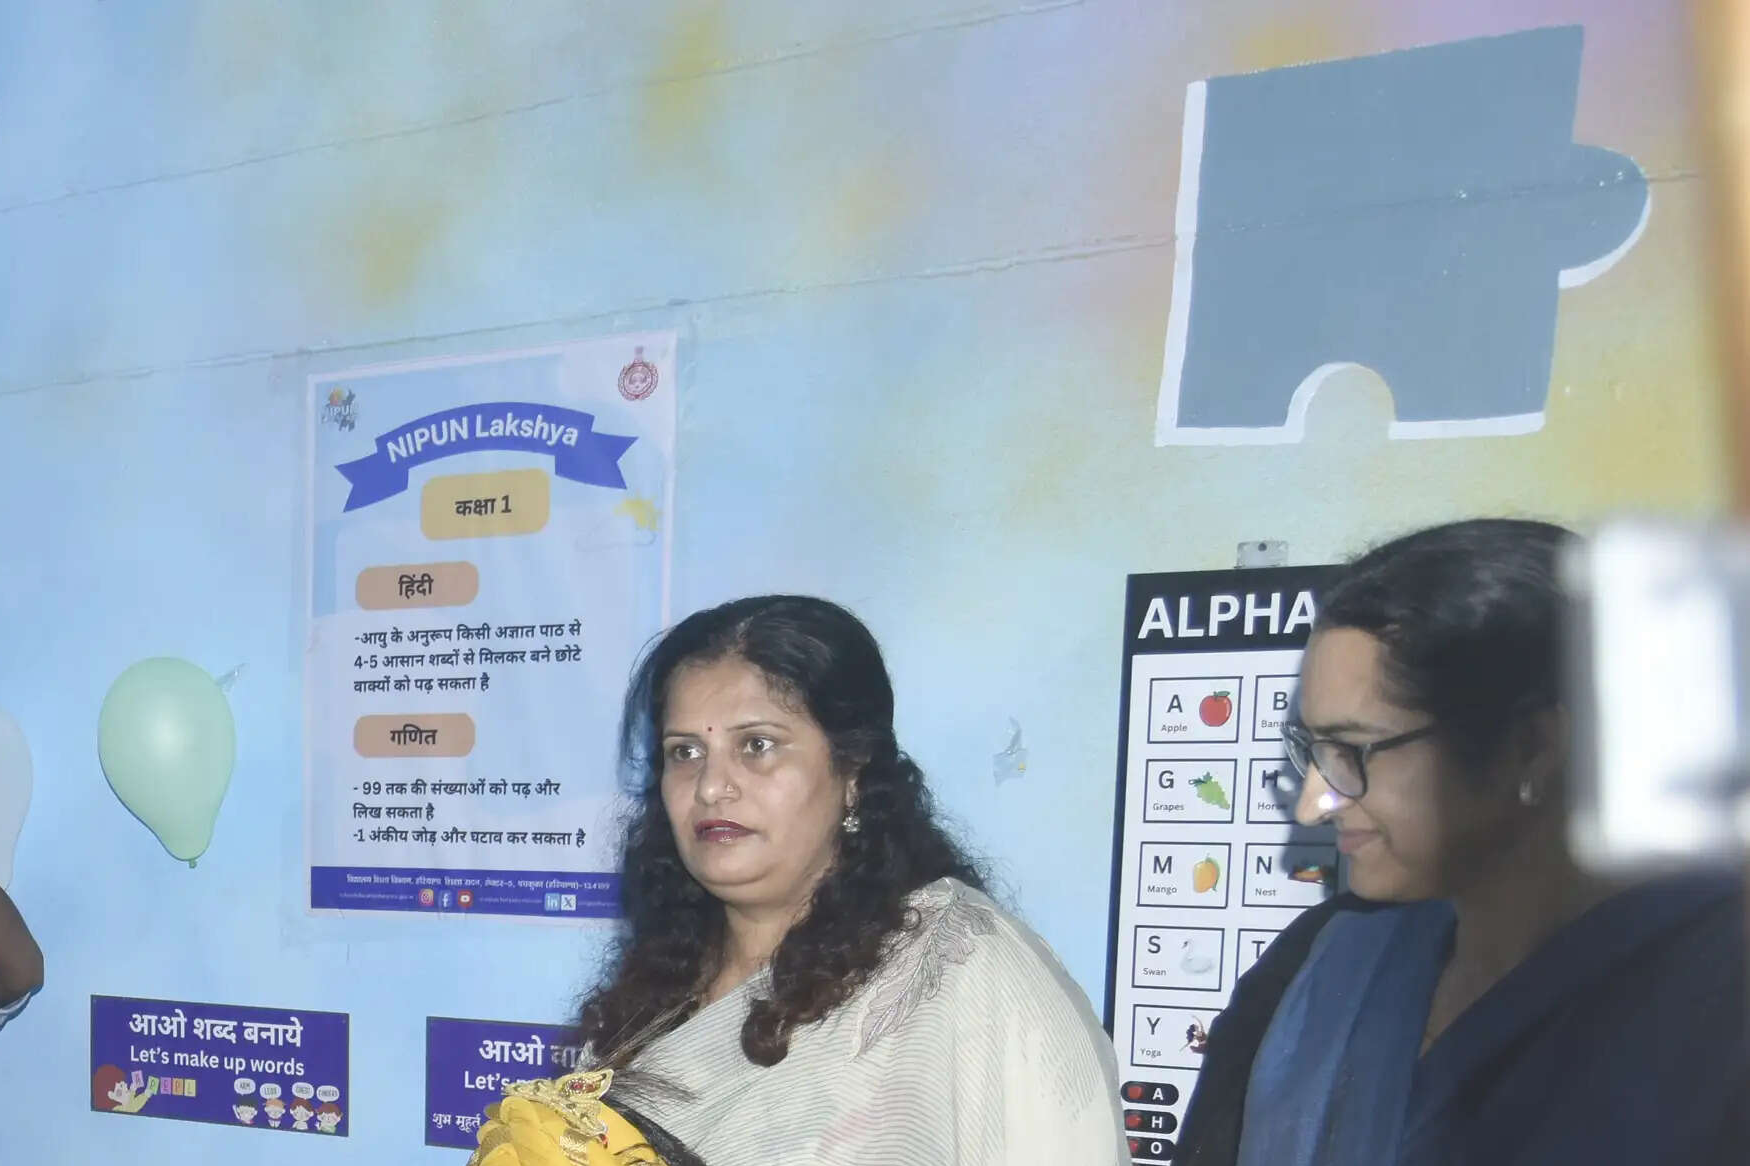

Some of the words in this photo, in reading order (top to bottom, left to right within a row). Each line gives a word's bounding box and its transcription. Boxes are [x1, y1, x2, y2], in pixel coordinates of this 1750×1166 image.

[387, 416, 469, 463] NIPUN
[476, 412, 579, 447] Lakshya
[455, 497, 495, 517] कक्षा
[502, 495, 512, 514] 1
[398, 573, 434, 599] हिंदी
[1138, 591, 1316, 639] ALPHA
[354, 632, 387, 648] -आयु
[391, 627, 403, 643] के
[407, 629, 452, 646] अनुरूप
[457, 623, 490, 640] किसी
[495, 625, 535, 639] अज्ञात
[540, 623, 565, 637] पाठ
[569, 619, 581, 636] से
[354, 655, 378, 669] 4-5
[382, 654, 424, 668] आसान
[429, 649, 459, 667] शब्दों
[463, 649, 475, 665] से
[479, 648, 526, 664] मिलकर
[530, 647, 550, 662] बने
[555, 644, 581, 662] छोटे
[354, 675, 390, 693] वाक्यों
[394, 674, 410, 692] को
[414, 679, 433, 695] पढ़
[438, 677, 476, 691] सकता
[480, 673, 490, 691] है
[1167, 694, 1183, 713] A
[1273, 691, 1289, 711] B
[390, 723, 437, 746] गणित
[1161, 724, 1188, 734] Apple
[1158, 771, 1174, 789] G
[1262, 770, 1278, 788] H
[363, 781, 382, 795] 99
[385, 782, 407, 795] तक
[411, 780, 427, 795] की
[431, 778, 485, 795] संख्याओं
[489, 779, 507, 795] को
[512, 782, 531, 799] पढ़
[535, 779, 560, 795] और
[353, 803, 382, 819] लिख
[385, 806, 422, 819] सकता
[426, 803, 435, 819] है
[1153, 802, 1185, 812] Grapes
[354, 829, 365, 843] -1
[369, 826, 408, 842] अंकीय
[412, 827, 437, 846] जोड़
[441, 828, 467, 844] और
[471, 831, 502, 844] घटाव
[507, 831, 527, 844] कर
[532, 832, 572, 845] सकता
[576, 828, 586, 848] है
[1154, 856, 1172, 874] M
[1256, 856, 1273, 874] N
[1147, 886, 1177, 895] Mango
[1255, 887, 1277, 897] Nest
[1147, 936, 1161, 954] S
[1251, 941, 1266, 959] T
[1143, 967, 1167, 976] Swan
[129, 1009, 187, 1038] आओ
[194, 1018, 237, 1044] शब्द
[243, 1016, 303, 1047] बनाये
[1147, 1017, 1161, 1035] Y
[479, 1035, 545, 1066] आओ
[1140, 1048, 1162, 1058] Yoga
[130, 1045, 170, 1065] Let's
[174, 1050, 219, 1068] make
[224, 1058, 246, 1075] up
[250, 1058, 305, 1076] words
[1152, 1087, 1164, 1100] A
[432, 1113, 451, 1128] शुभ
[1152, 1116, 1163, 1128] H
[1150, 1142, 1162, 1154] O
